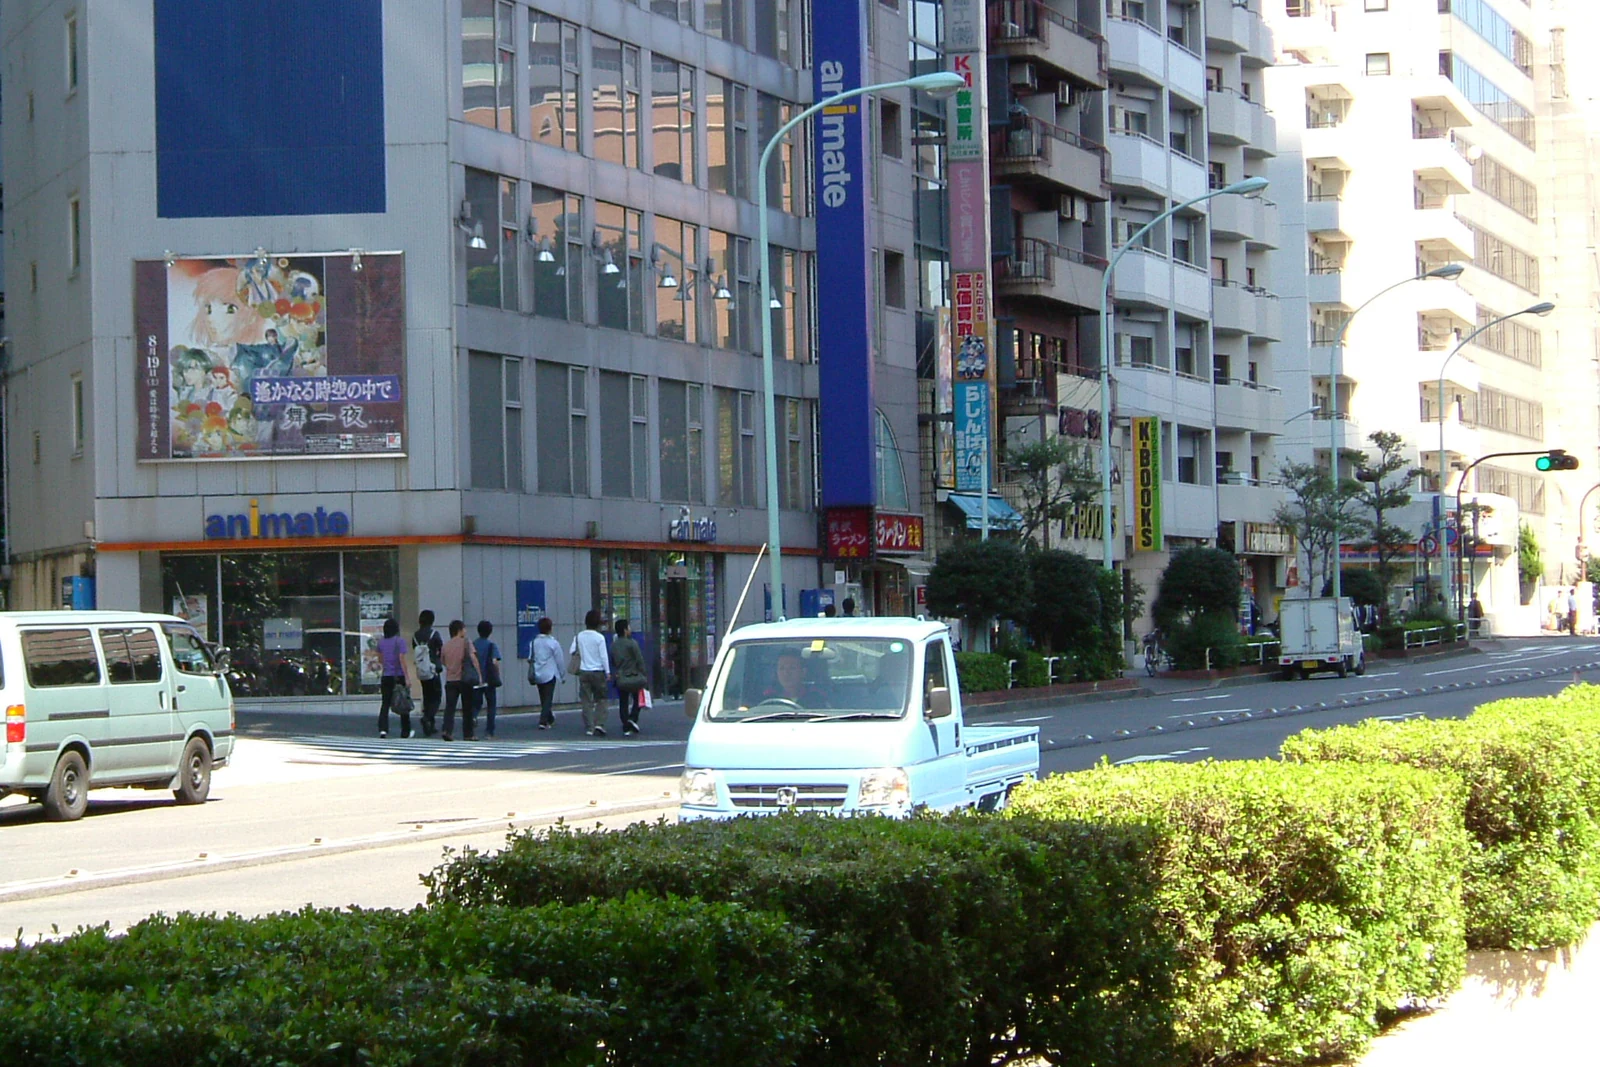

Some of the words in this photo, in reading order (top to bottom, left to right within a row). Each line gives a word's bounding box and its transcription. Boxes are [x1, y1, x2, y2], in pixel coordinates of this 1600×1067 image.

[820, 60, 857, 208] animate
[956, 274, 973, 337] 高価買取
[281, 404, 367, 430] 舞一夜
[205, 498, 350, 538] animate
[832, 533, 867, 546] ラーメン
